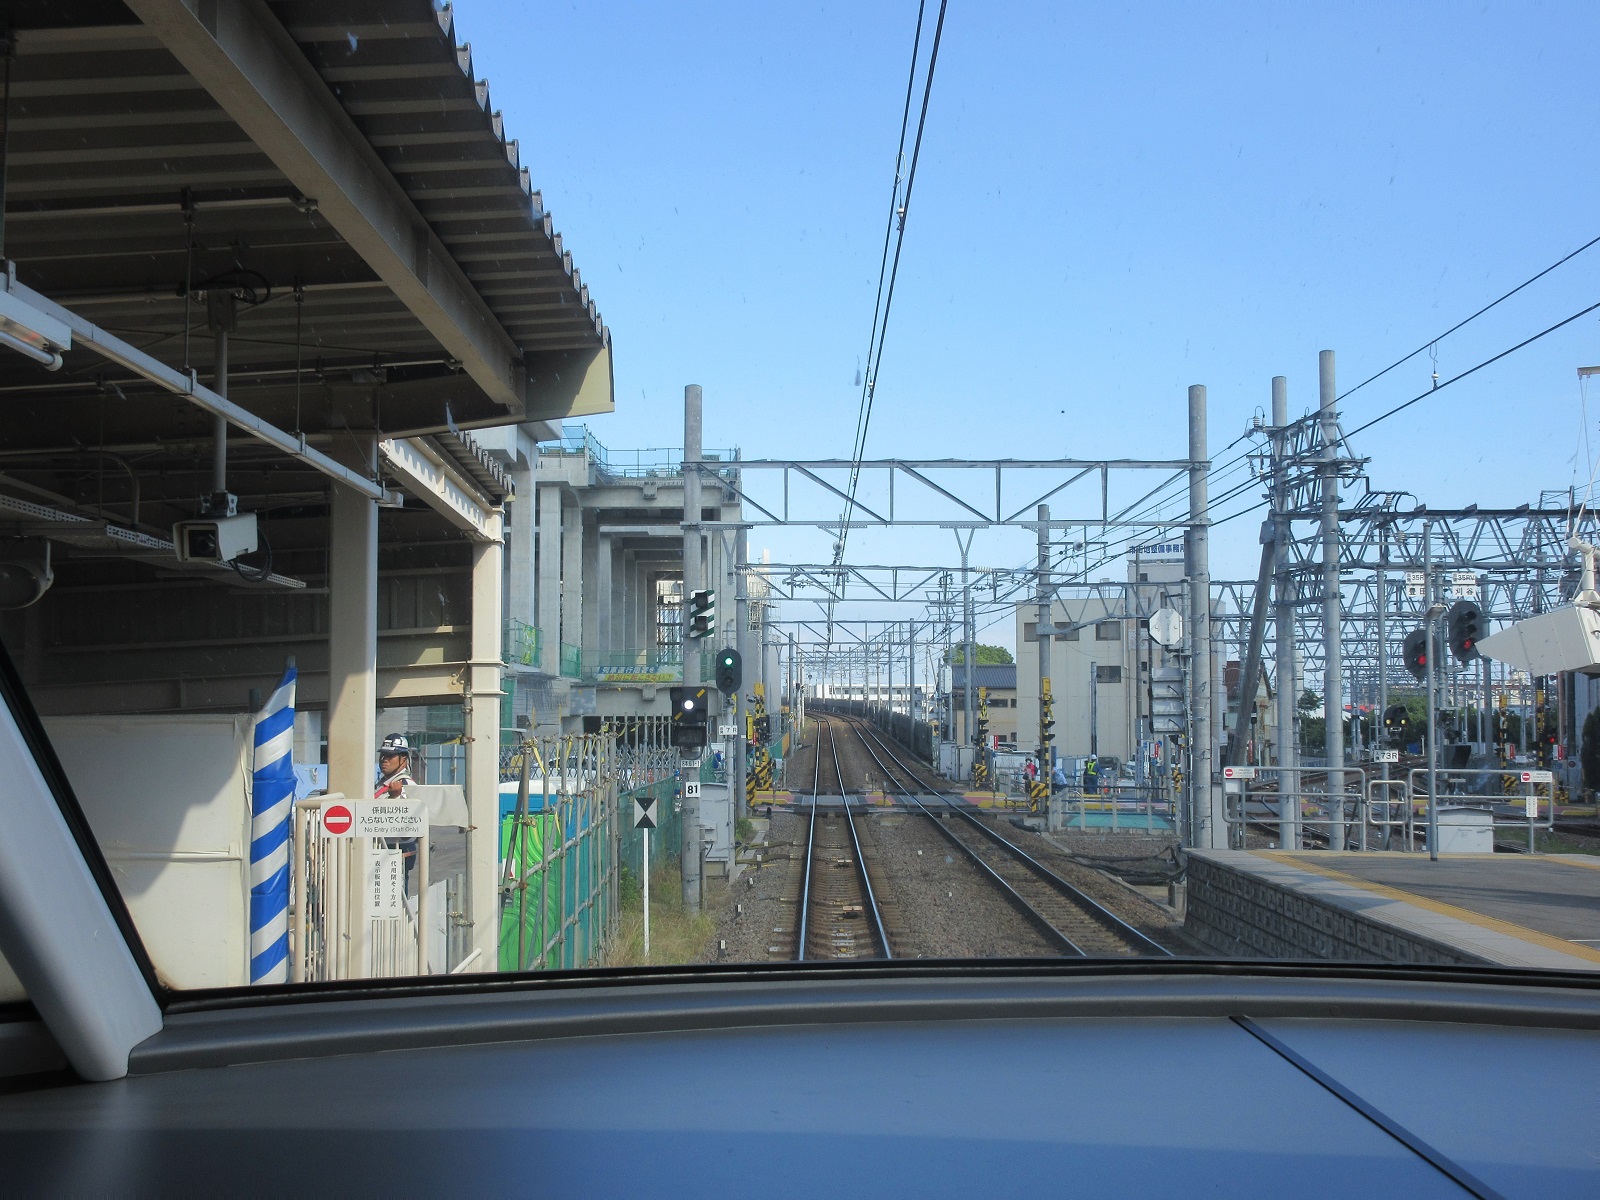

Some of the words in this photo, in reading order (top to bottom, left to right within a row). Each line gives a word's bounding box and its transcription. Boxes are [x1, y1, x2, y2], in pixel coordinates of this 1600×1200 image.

[1454, 587, 1474, 596] 刈谷
[687, 785, 698, 794] 81
[372, 806, 409, 814] 係員以外は
[360, 815, 422, 825] 入らないでください
[374, 826, 389, 834] Entry
